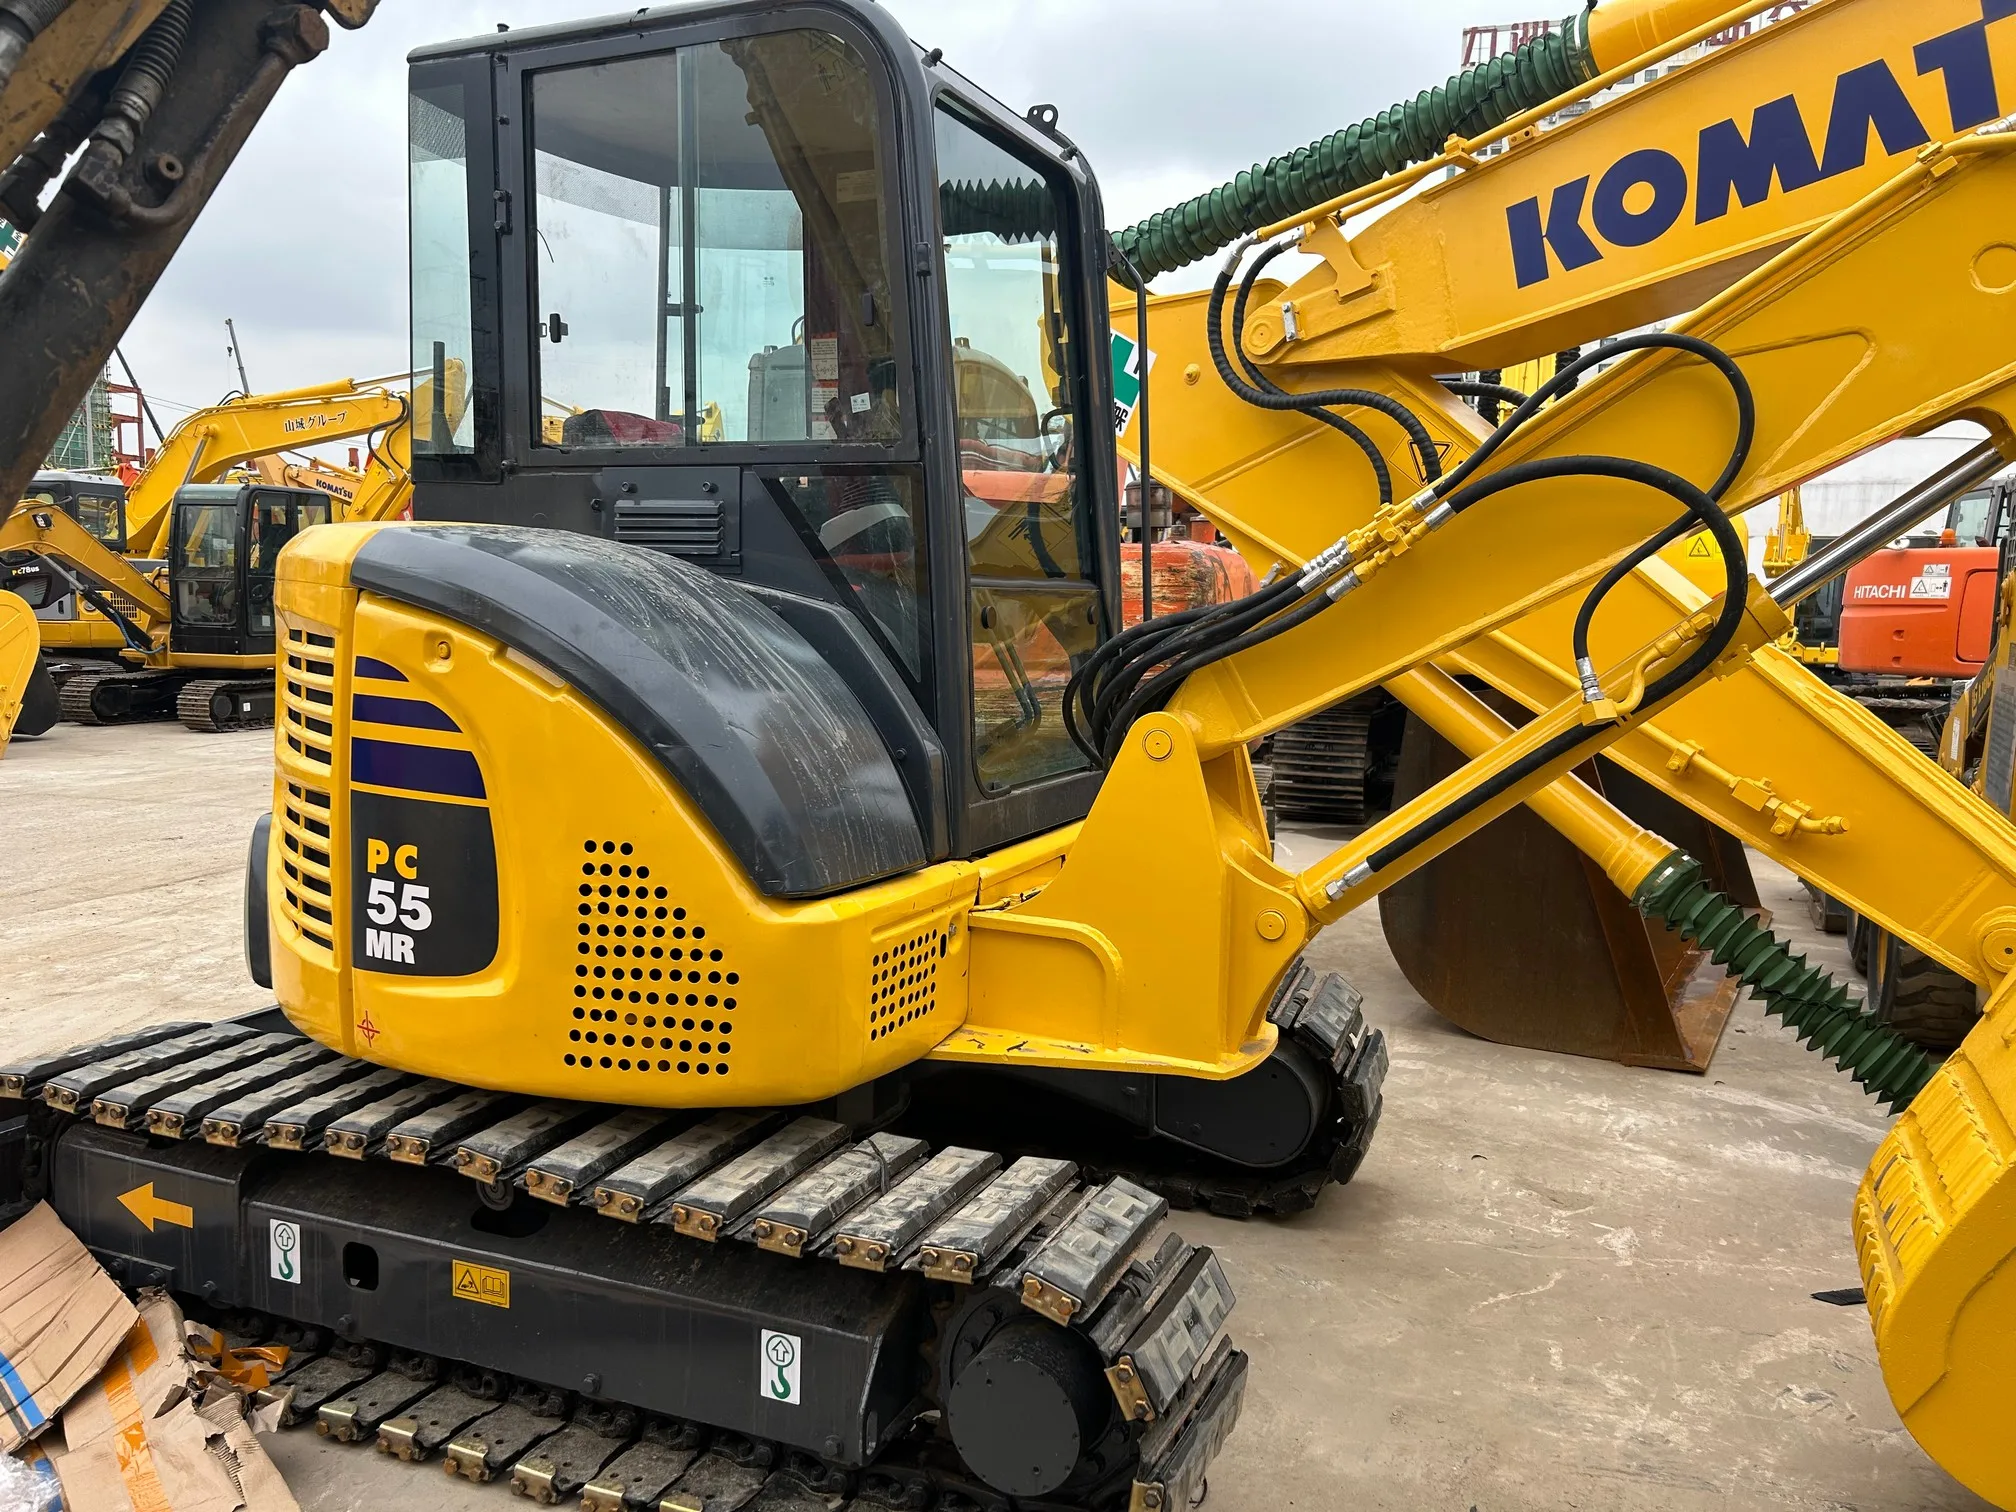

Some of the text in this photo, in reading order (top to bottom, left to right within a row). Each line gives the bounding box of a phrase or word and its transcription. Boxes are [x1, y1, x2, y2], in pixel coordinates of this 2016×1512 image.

[1505, 0, 2016, 289] KOMAT
[285, 411, 347, 432] 山城グループ
[316, 479, 353, 499] KOMATSU
[1853, 585, 1906, 599] HITACHI
[367, 838, 418, 880] PC
[366, 877, 433, 931] 55
[365, 927, 416, 965] MR
